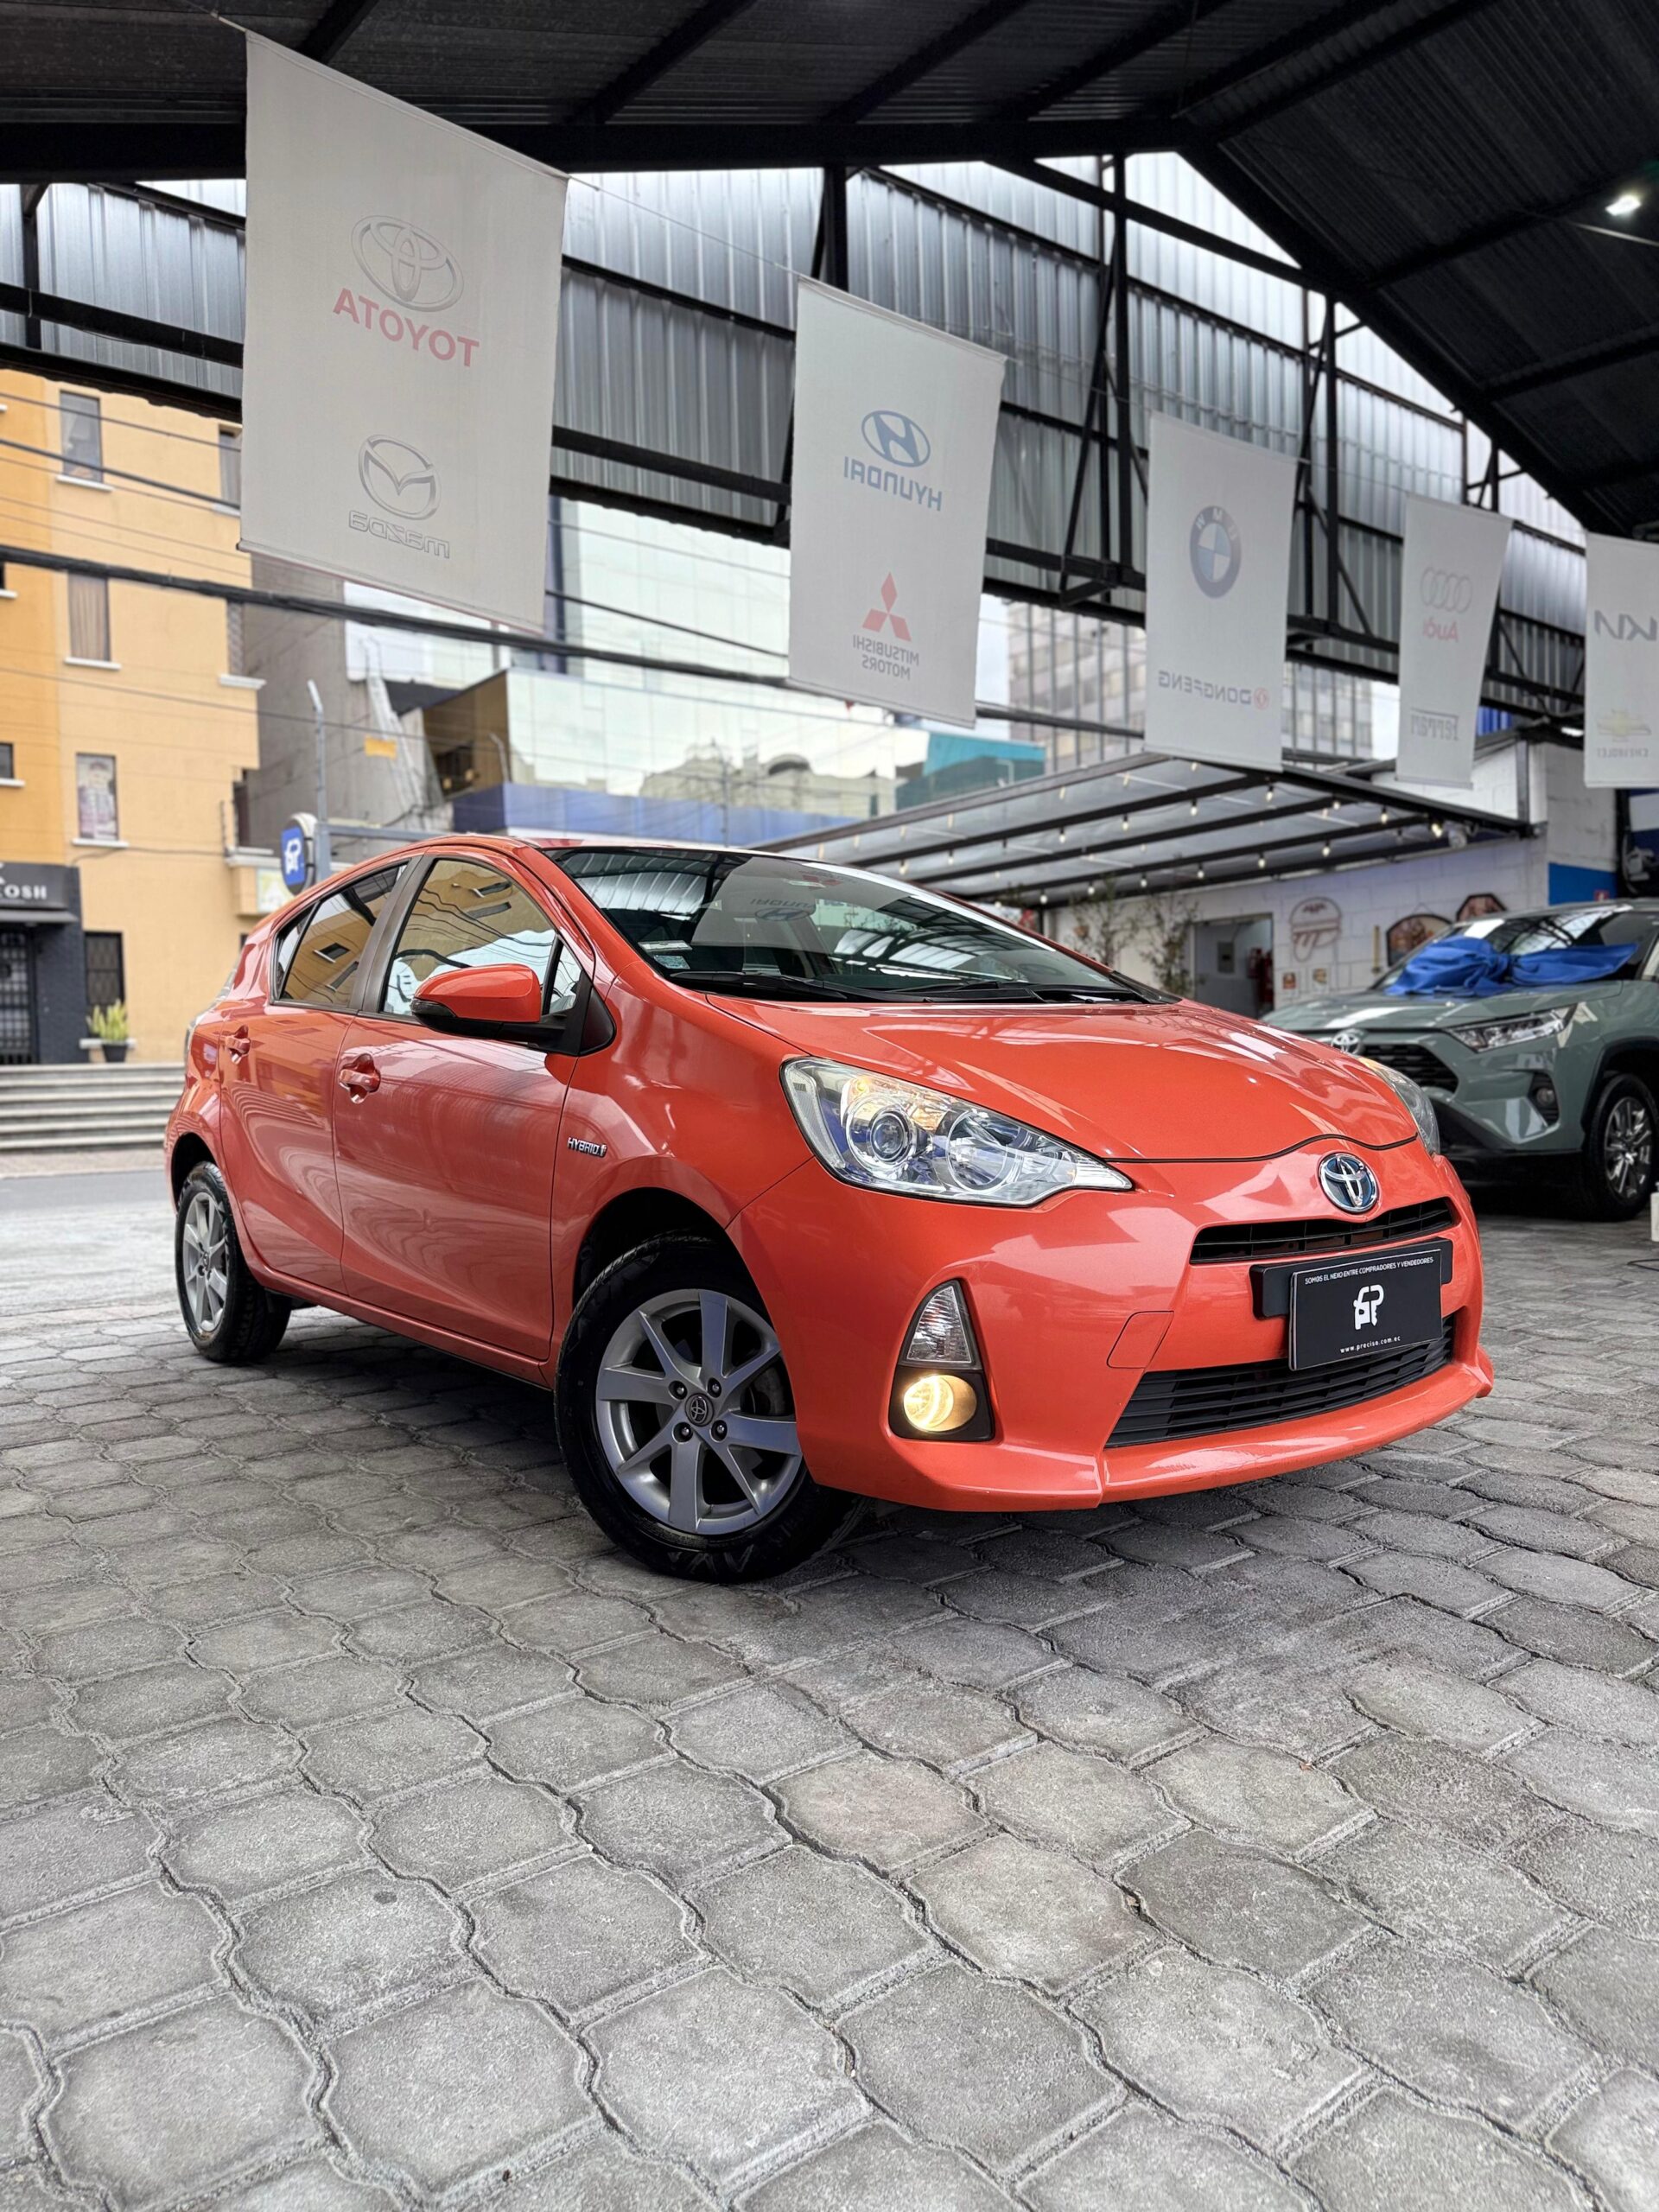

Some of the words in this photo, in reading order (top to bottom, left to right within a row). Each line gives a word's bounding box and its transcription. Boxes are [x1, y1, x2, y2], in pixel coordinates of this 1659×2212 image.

[0, 884, 48, 899] OSH
[567, 1137, 601, 1155] HYBRID
[1305, 1274, 1323, 1285] SOMOS
[1343, 1268, 1358, 1277] ENTRE
[1359, 1262, 1397, 1274] COMPRADORES
[1401, 1257, 1433, 1268] VENDEDORES
